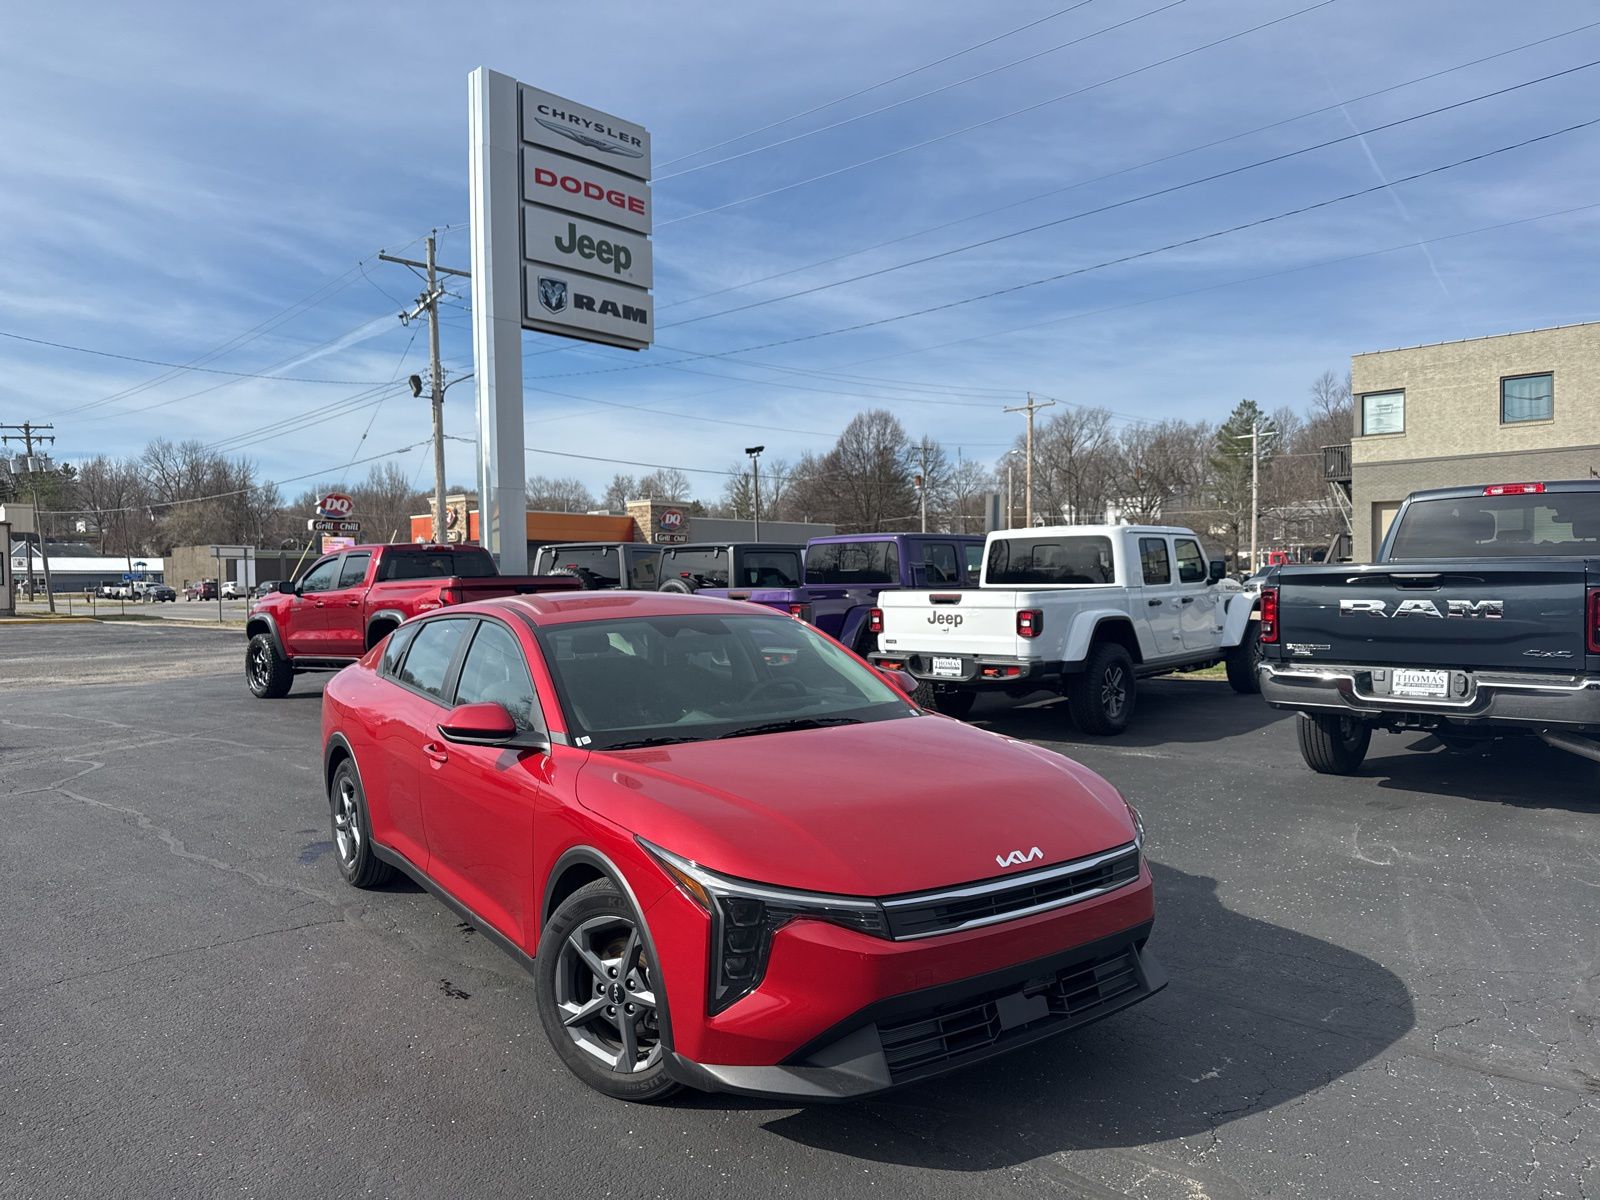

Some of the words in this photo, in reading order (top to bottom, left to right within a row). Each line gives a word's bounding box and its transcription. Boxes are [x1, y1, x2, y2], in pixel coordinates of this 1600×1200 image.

[536, 104, 643, 148] CHRYSLER
[534, 167, 645, 216] DODGE
[554, 222, 632, 274] Jeep
[573, 292, 648, 325] RAM
[325, 498, 349, 513] DQ
[315, 521, 334, 530] Grill
[340, 522, 359, 531] Chill
[665, 513, 681, 525] DQ
[927, 610, 964, 627] Jeep
[1338, 599, 1504, 619] RAM
[1395, 674, 1445, 684] THOMAS
[995, 846, 1044, 868] KIA
